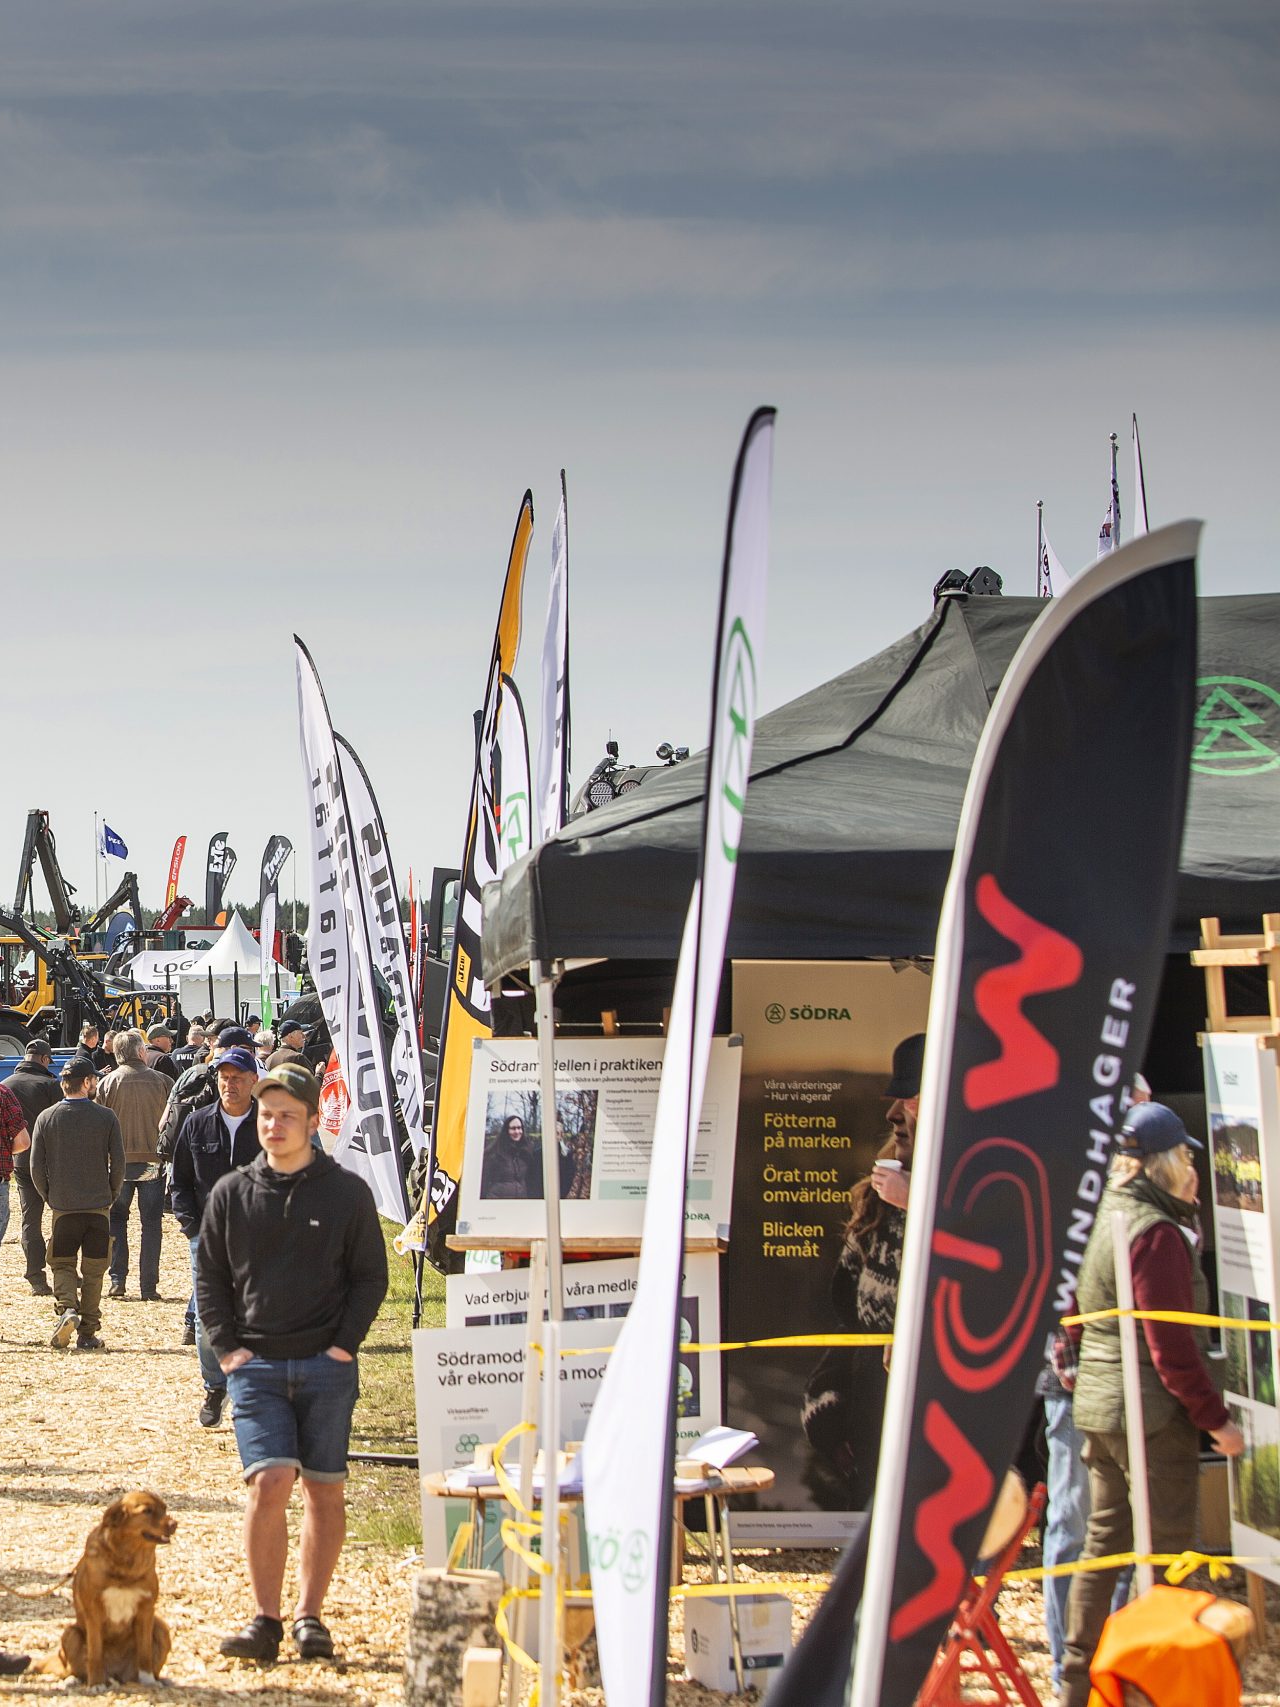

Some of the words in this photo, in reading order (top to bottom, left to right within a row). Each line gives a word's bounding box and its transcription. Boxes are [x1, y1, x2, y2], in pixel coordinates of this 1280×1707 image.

[789, 1004, 852, 1020] SÖDRA
[490, 1059, 590, 1073] Södramdellen
[599, 1058, 663, 1074] praktiken
[764, 1080, 786, 1089] Våra
[787, 1080, 842, 1092] värderingar
[771, 1092, 789, 1101] Hur
[790, 1092, 799, 1101] vi
[800, 1093, 832, 1103] agerar
[764, 1112, 837, 1128] Fötterna
[764, 1131, 785, 1152] på
[788, 1133, 851, 1148] marken
[1053, 977, 1137, 1312] WINDHAGER
[763, 1164, 801, 1182] Örat
[804, 1168, 839, 1182] mot
[763, 1187, 853, 1203] omvärlden
[762, 1221, 825, 1237] Blicken
[762, 1239, 820, 1257] framåt
[465, 1292, 490, 1305] Vad
[566, 1281, 595, 1296] våra
[438, 1369, 465, 1387] vår
